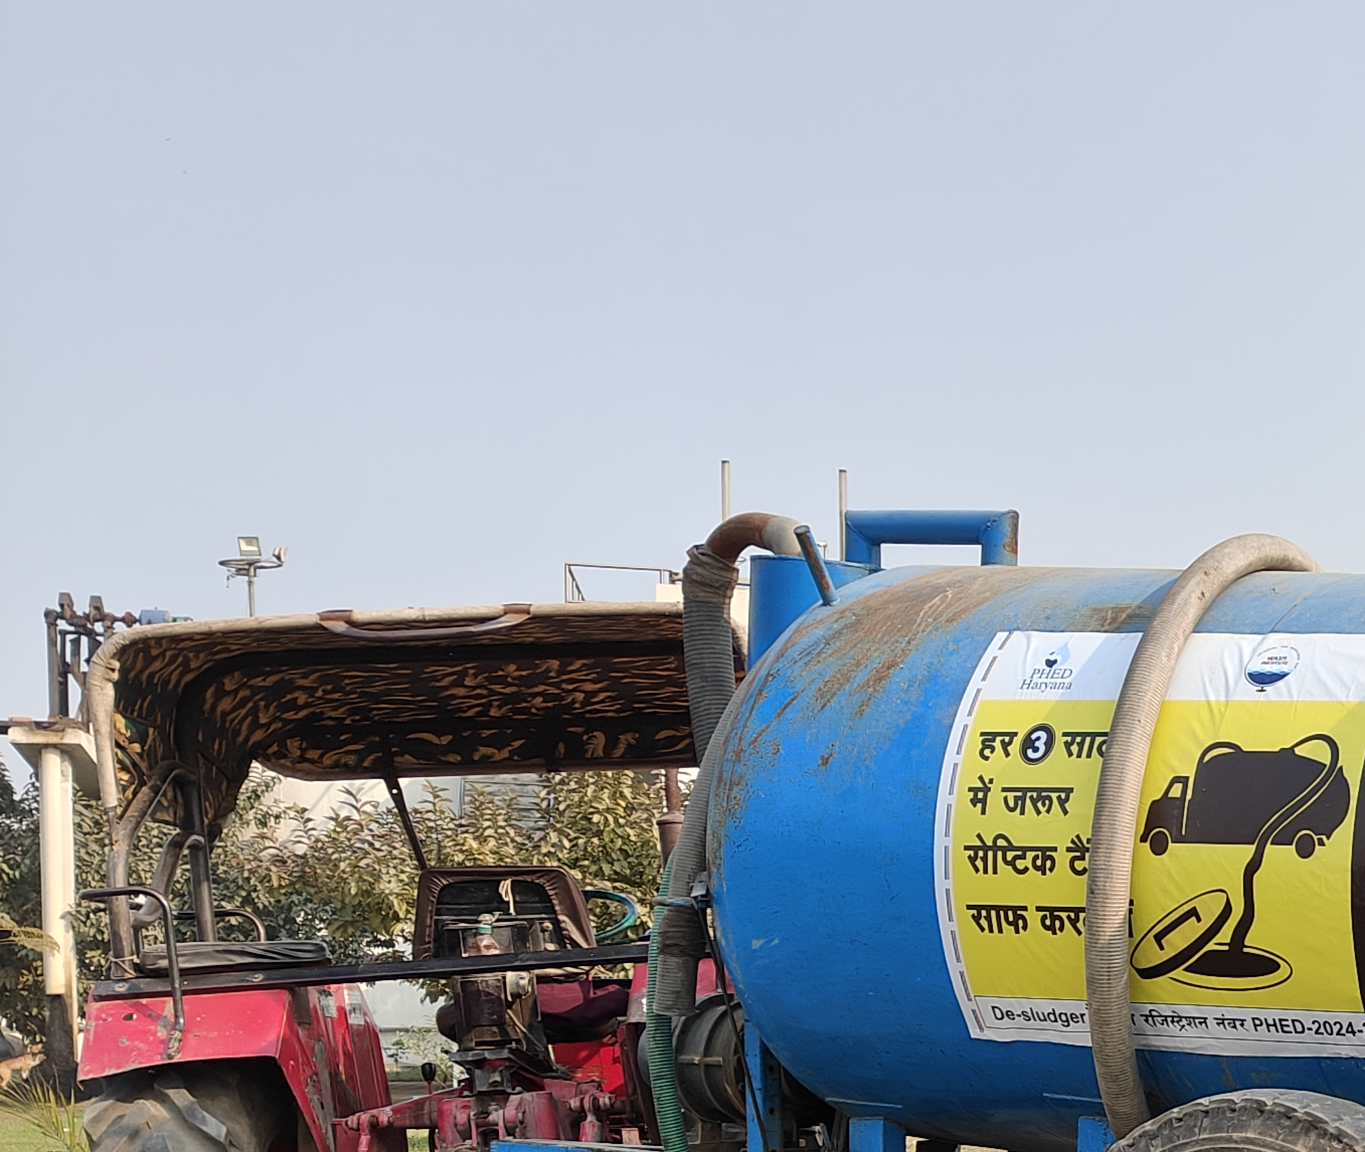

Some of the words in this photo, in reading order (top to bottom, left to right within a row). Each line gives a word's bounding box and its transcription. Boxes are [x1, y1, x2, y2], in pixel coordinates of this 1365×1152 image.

[1019, 679, 1073, 693] Haryana
[1031, 668, 1073, 680] PHED
[979, 731, 1019, 761] हर
[1026, 729, 1049, 760] 3
[967, 774, 994, 816] में
[1001, 786, 1074, 817] जरूर
[963, 832, 1058, 876] सेप्टिक
[1066, 833, 1092, 876] टैं
[965, 903, 1028, 935] साफ
[991, 1005, 1086, 1028] De-sludger
[1140, 1008, 1209, 1032] रजिस्ट्रेशन
[1213, 1013, 1249, 1032] नंबर
